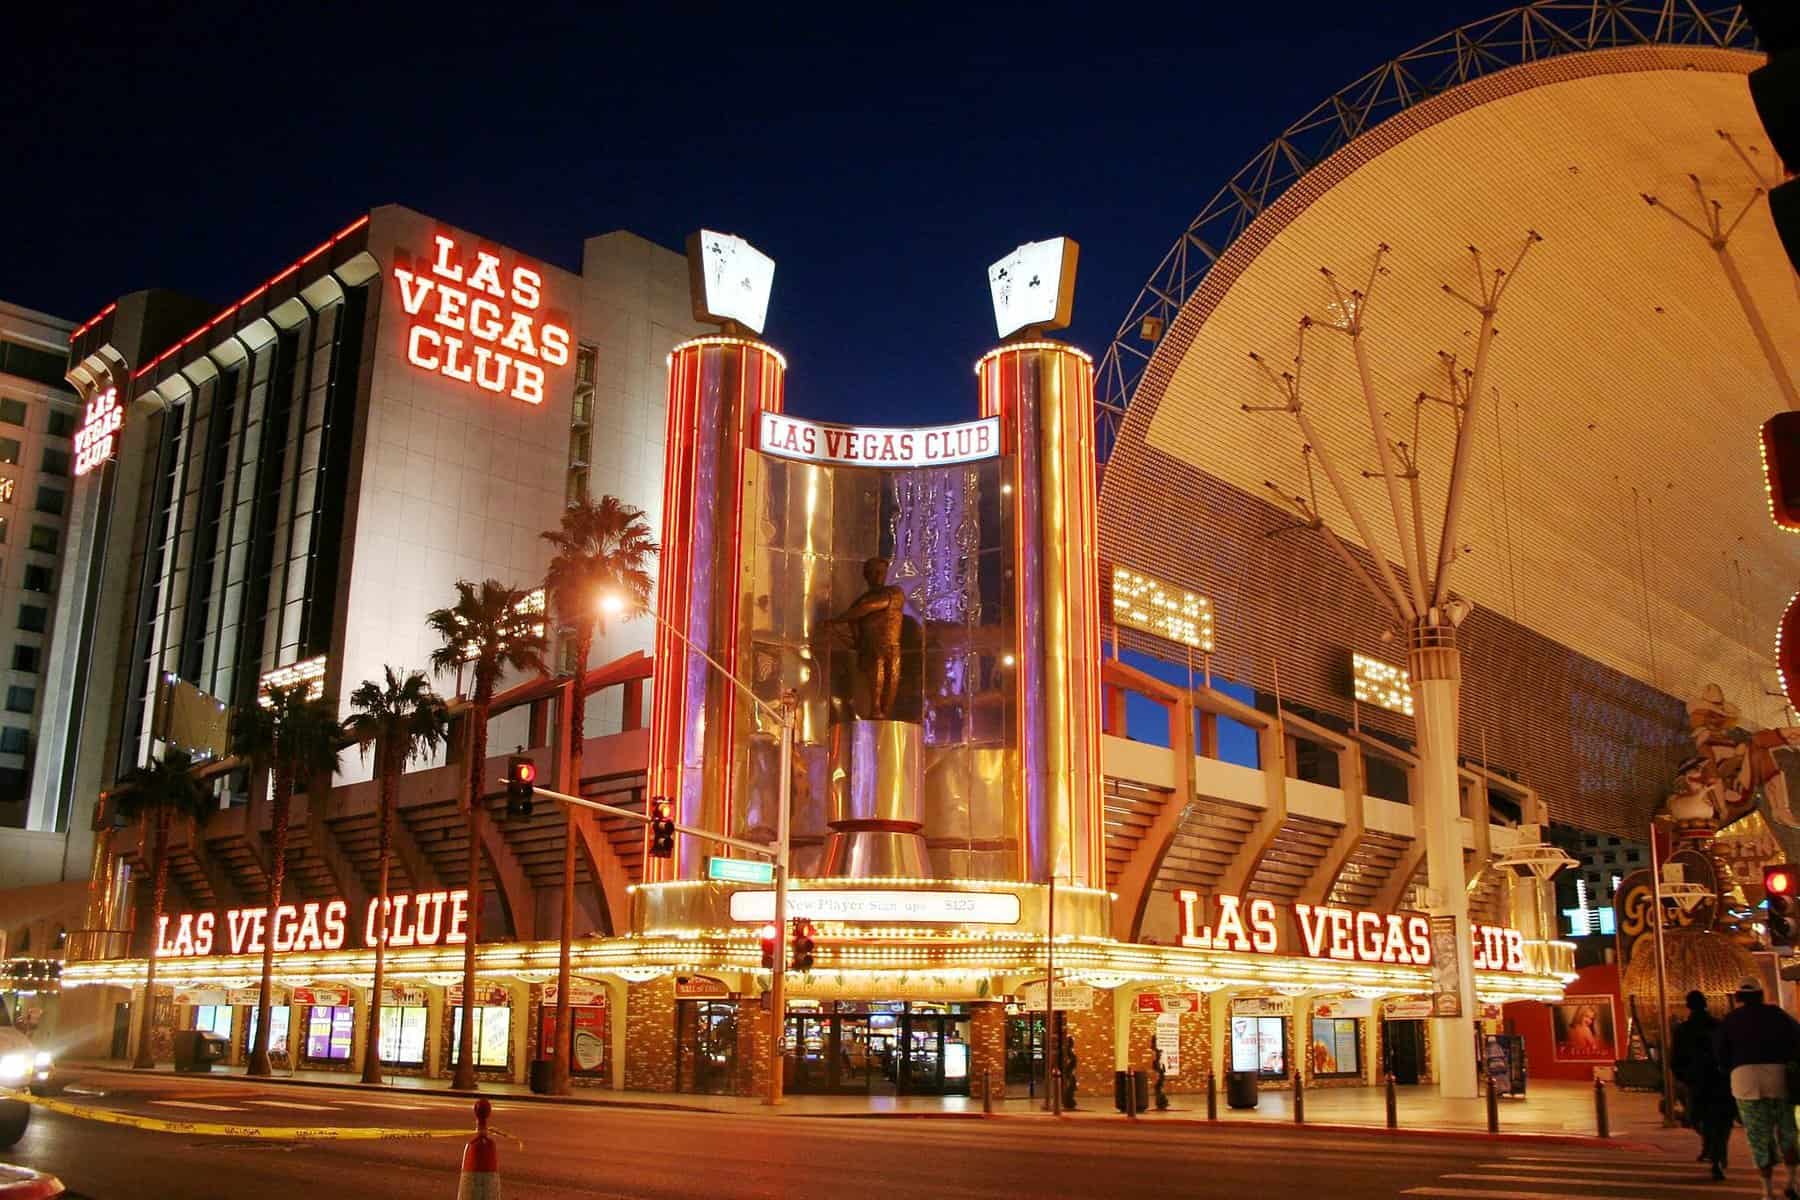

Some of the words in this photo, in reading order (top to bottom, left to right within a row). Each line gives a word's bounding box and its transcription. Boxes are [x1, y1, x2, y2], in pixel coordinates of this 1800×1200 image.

[432, 235, 542, 309] LAS
[394, 268, 570, 366] VEGAS
[408, 324, 545, 405] CLUB
[768, 419, 816, 455] LAS
[823, 429, 914, 461] VEGAS
[925, 425, 990, 459] CLUB
[155, 911, 215, 957] LAS
[227, 901, 347, 954] VEGAS
[817, 898, 864, 913] Player
[1179, 889, 1278, 953] LAS
[1295, 903, 1431, 965] VEGAS
[1471, 924, 1526, 971] LUB
